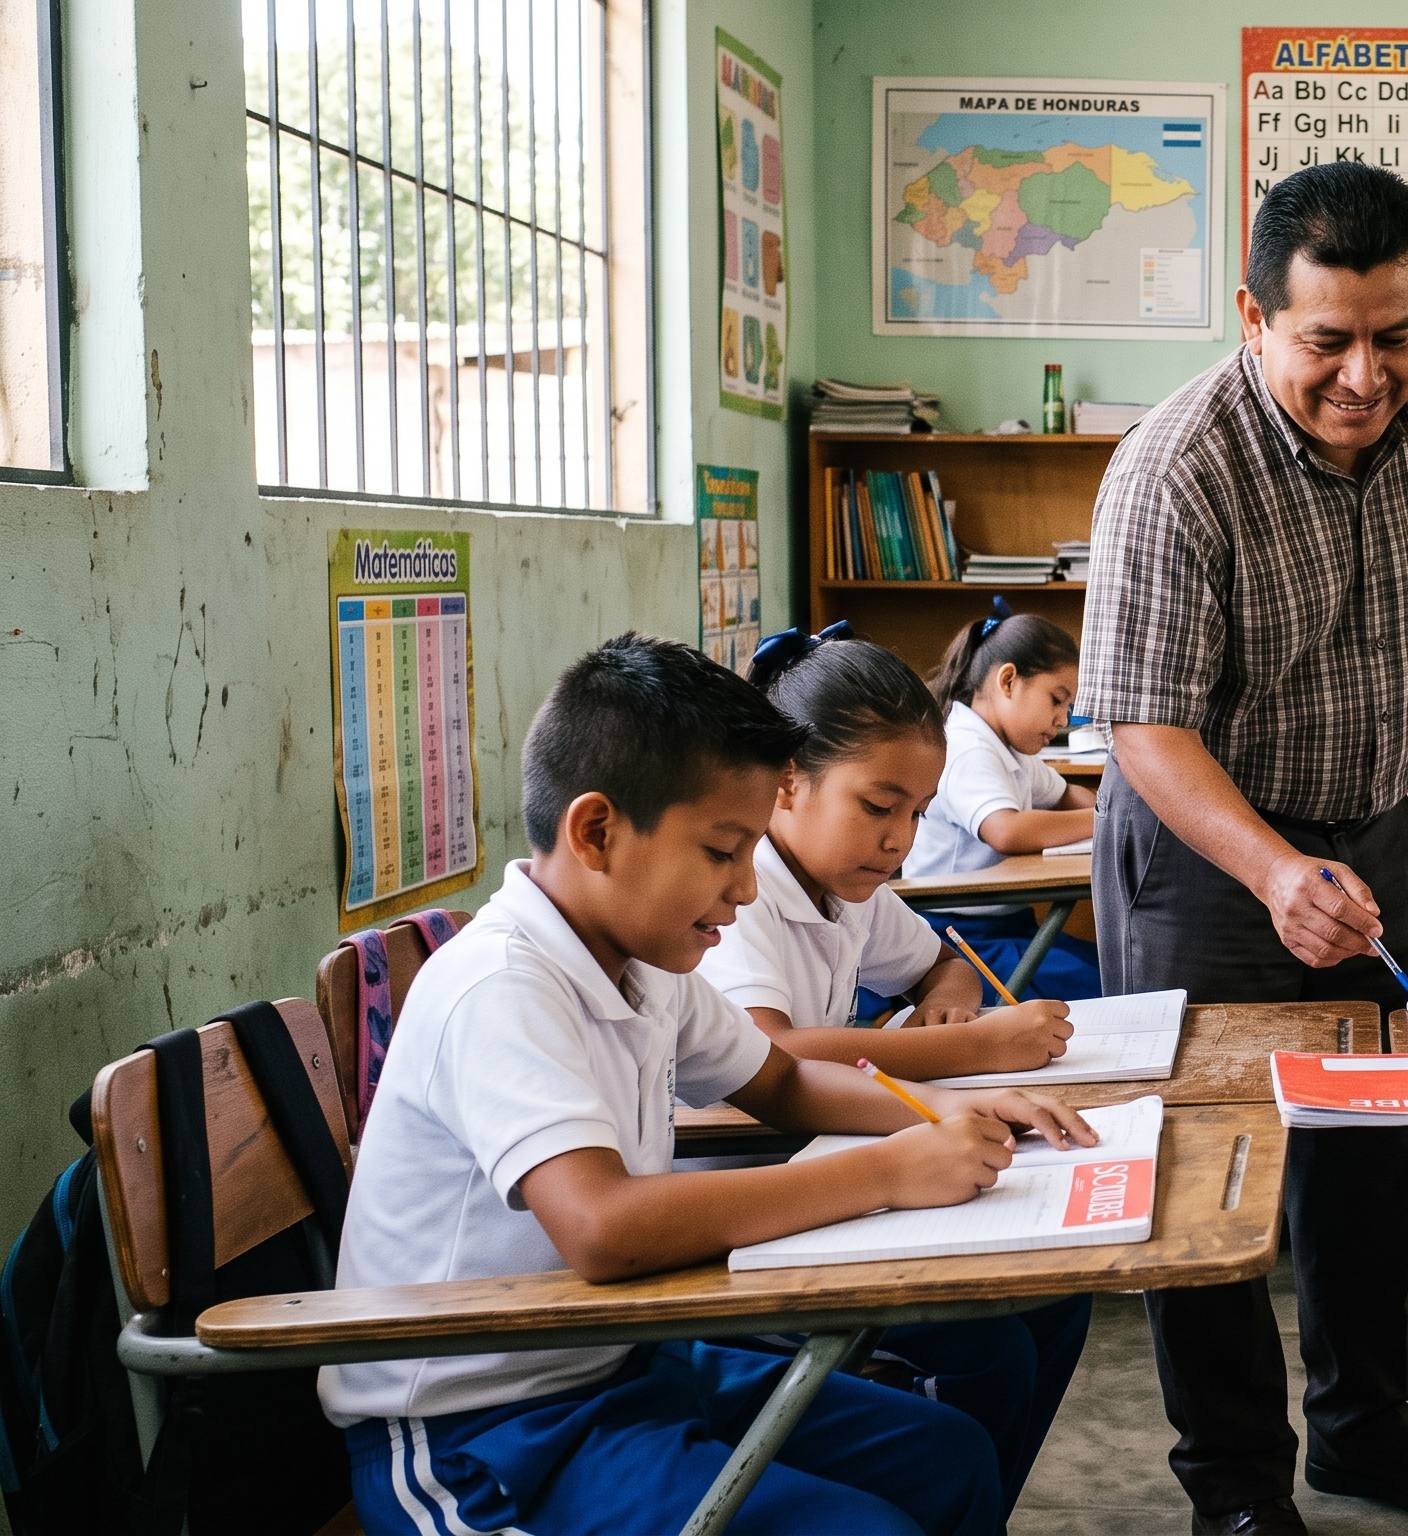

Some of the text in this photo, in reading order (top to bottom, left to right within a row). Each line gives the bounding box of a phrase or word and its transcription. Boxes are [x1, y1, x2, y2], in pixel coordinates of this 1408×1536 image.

[1253, 80, 1285, 100] Aa
[1295, 80, 1327, 101] Bb
[1337, 81, 1368, 101] Cc
[1378, 82, 1408, 102] Dd
[959, 96, 1142, 114] MAPA DE HONDURAS
[1257, 112, 1281, 133] Ff
[1294, 113, 1328, 138] Gg
[1337, 113, 1369, 133] Hh
[1258, 147, 1280, 171] Jj
[1380, 148, 1400, 167] Ll
[355, 542, 457, 580] Matemáticas
